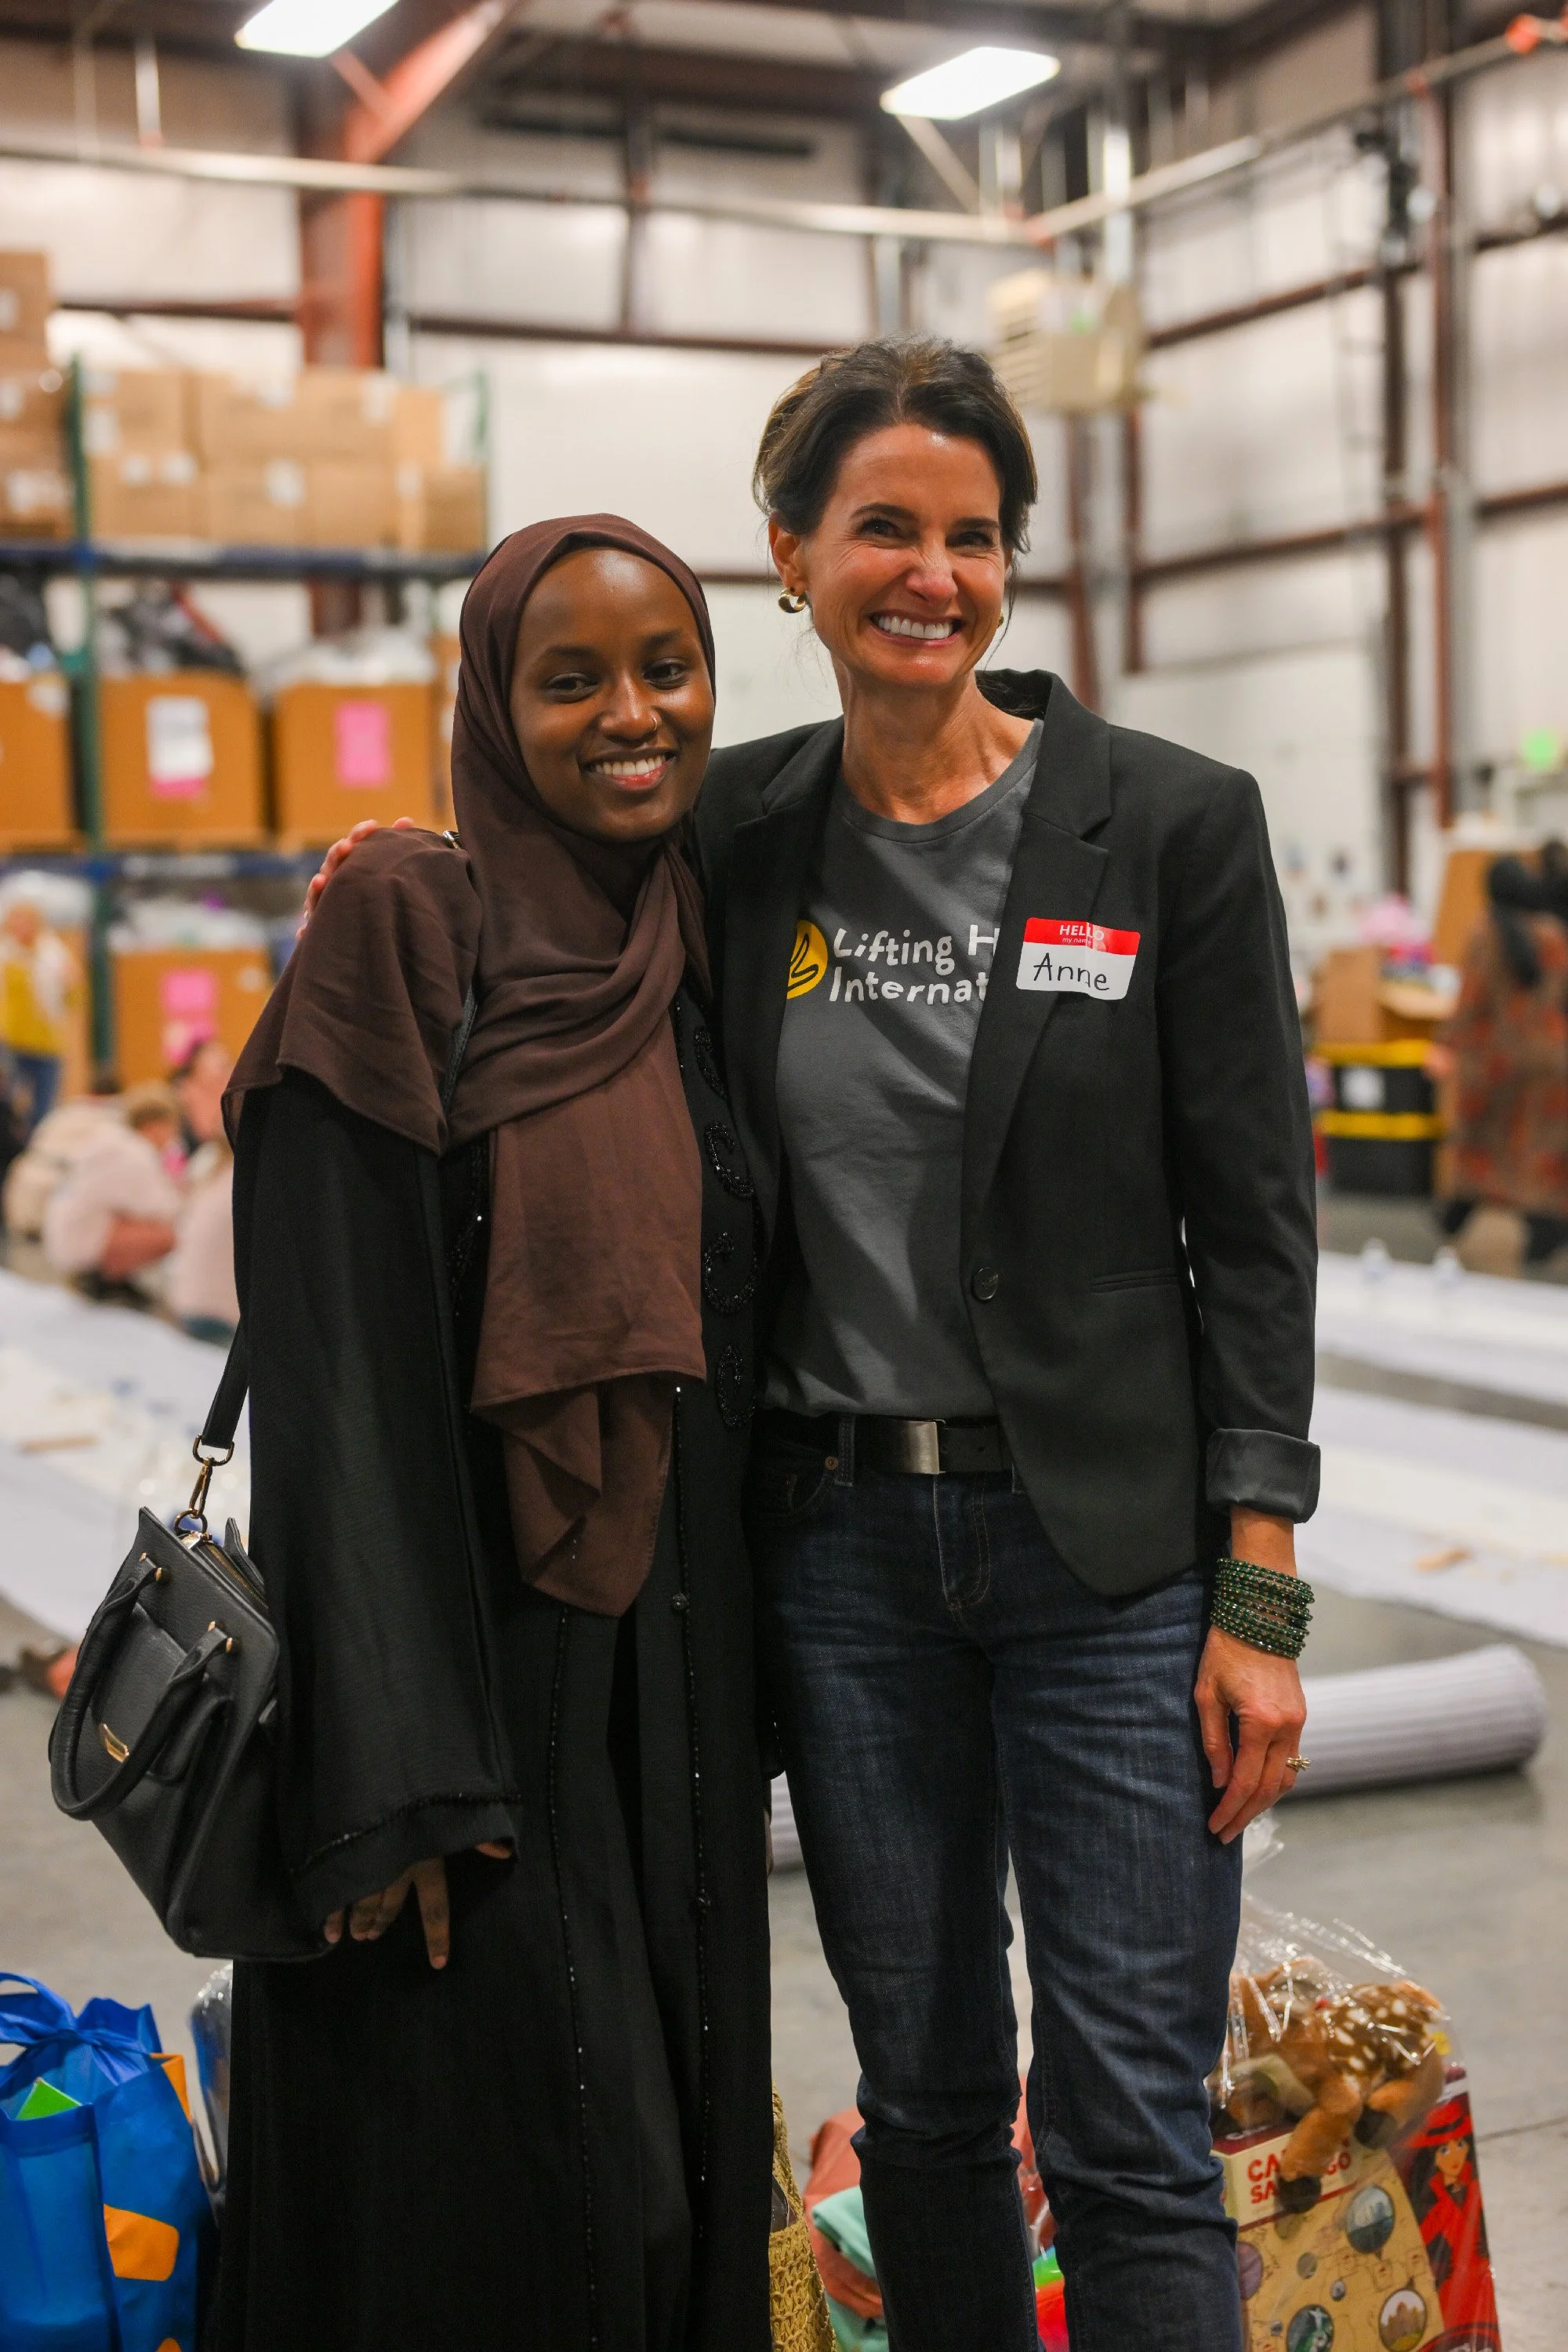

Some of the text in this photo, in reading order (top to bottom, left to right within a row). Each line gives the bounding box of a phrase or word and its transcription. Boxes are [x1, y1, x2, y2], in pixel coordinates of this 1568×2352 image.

[1059, 924, 1104, 940] HELLO
[833, 928, 955, 975] Lifting
[829, 966, 989, 1005] Internat
[1033, 953, 1109, 991] Anne
